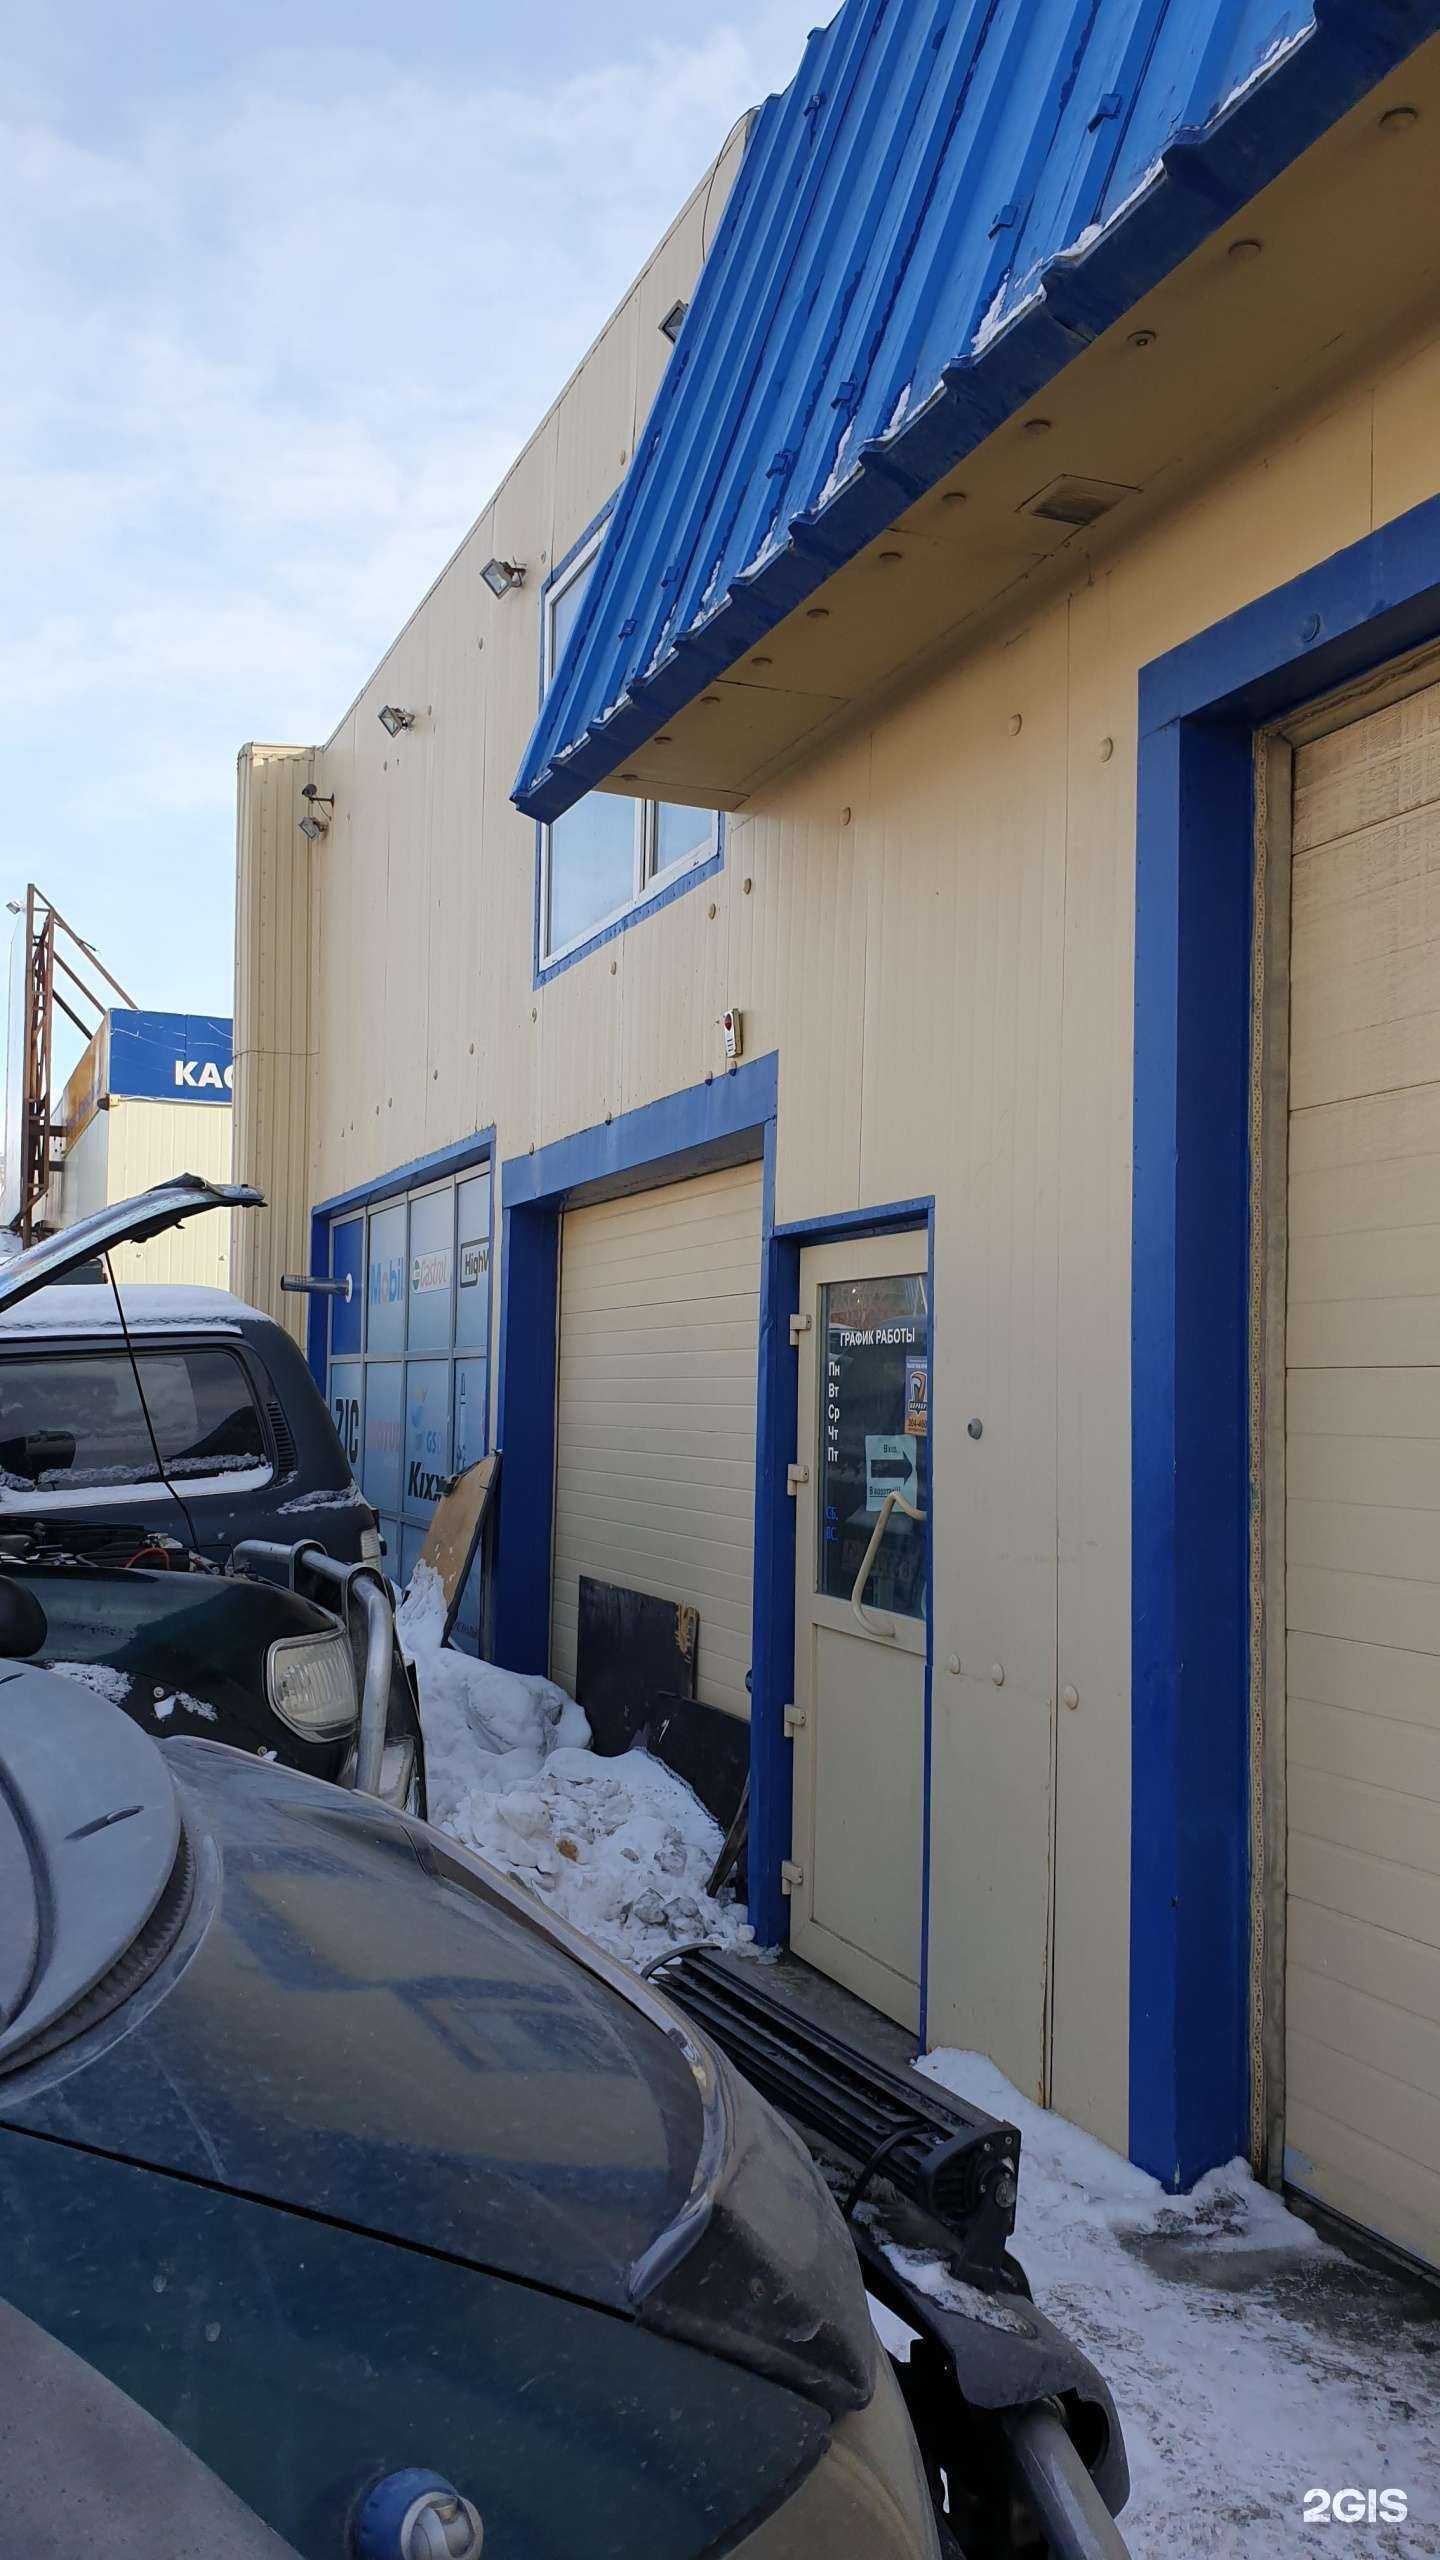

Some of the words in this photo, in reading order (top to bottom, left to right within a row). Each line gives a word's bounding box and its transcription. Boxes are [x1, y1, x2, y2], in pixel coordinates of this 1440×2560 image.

[371, 1257, 404, 1305] Mobil
[840, 1330, 874, 1347] ГРАФИК
[876, 1327, 915, 1345] РАБОТЫ
[828, 1361, 840, 1377] Пн
[828, 1382, 840, 1398] Вт
[828, 1403, 840, 1423] Ср
[828, 1425, 839, 1441] Чт
[827, 1446, 839, 1462] Пт
